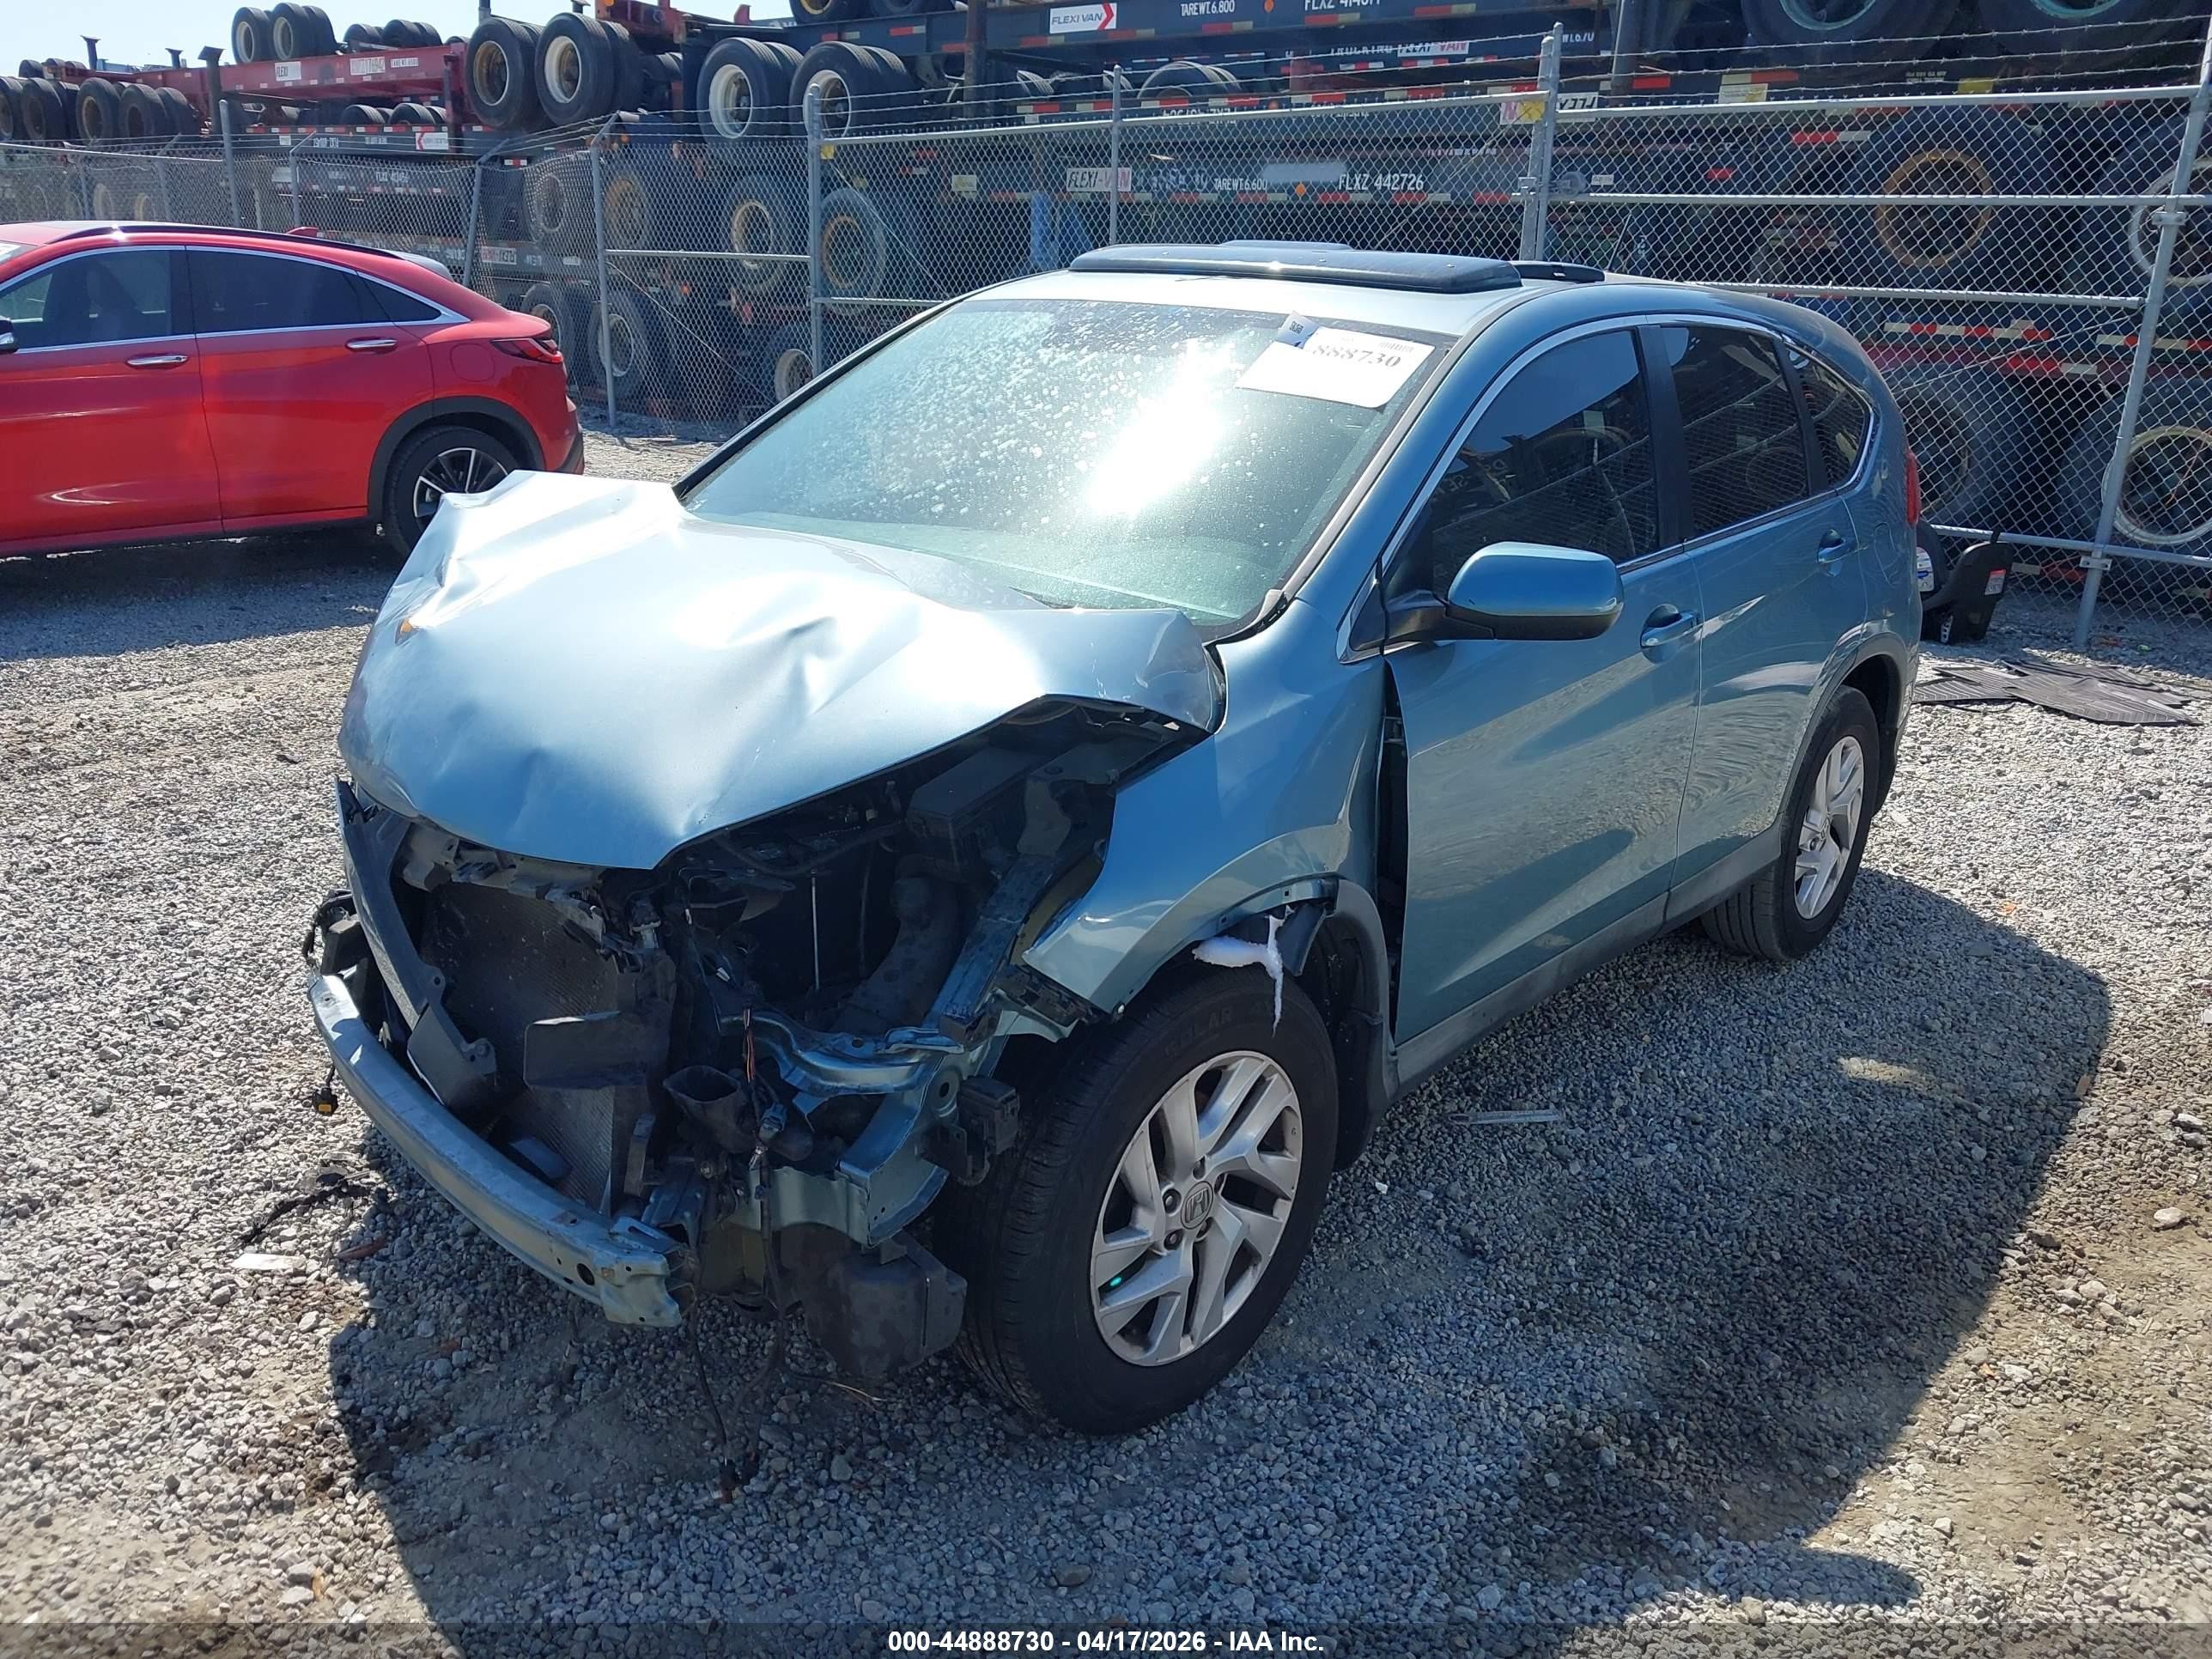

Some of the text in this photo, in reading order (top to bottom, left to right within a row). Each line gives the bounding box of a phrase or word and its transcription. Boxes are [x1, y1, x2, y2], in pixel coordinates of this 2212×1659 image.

[1051, 13, 1103, 25] FLEXI VAN
[1339, 173, 1425, 191] FLXZ 442726
